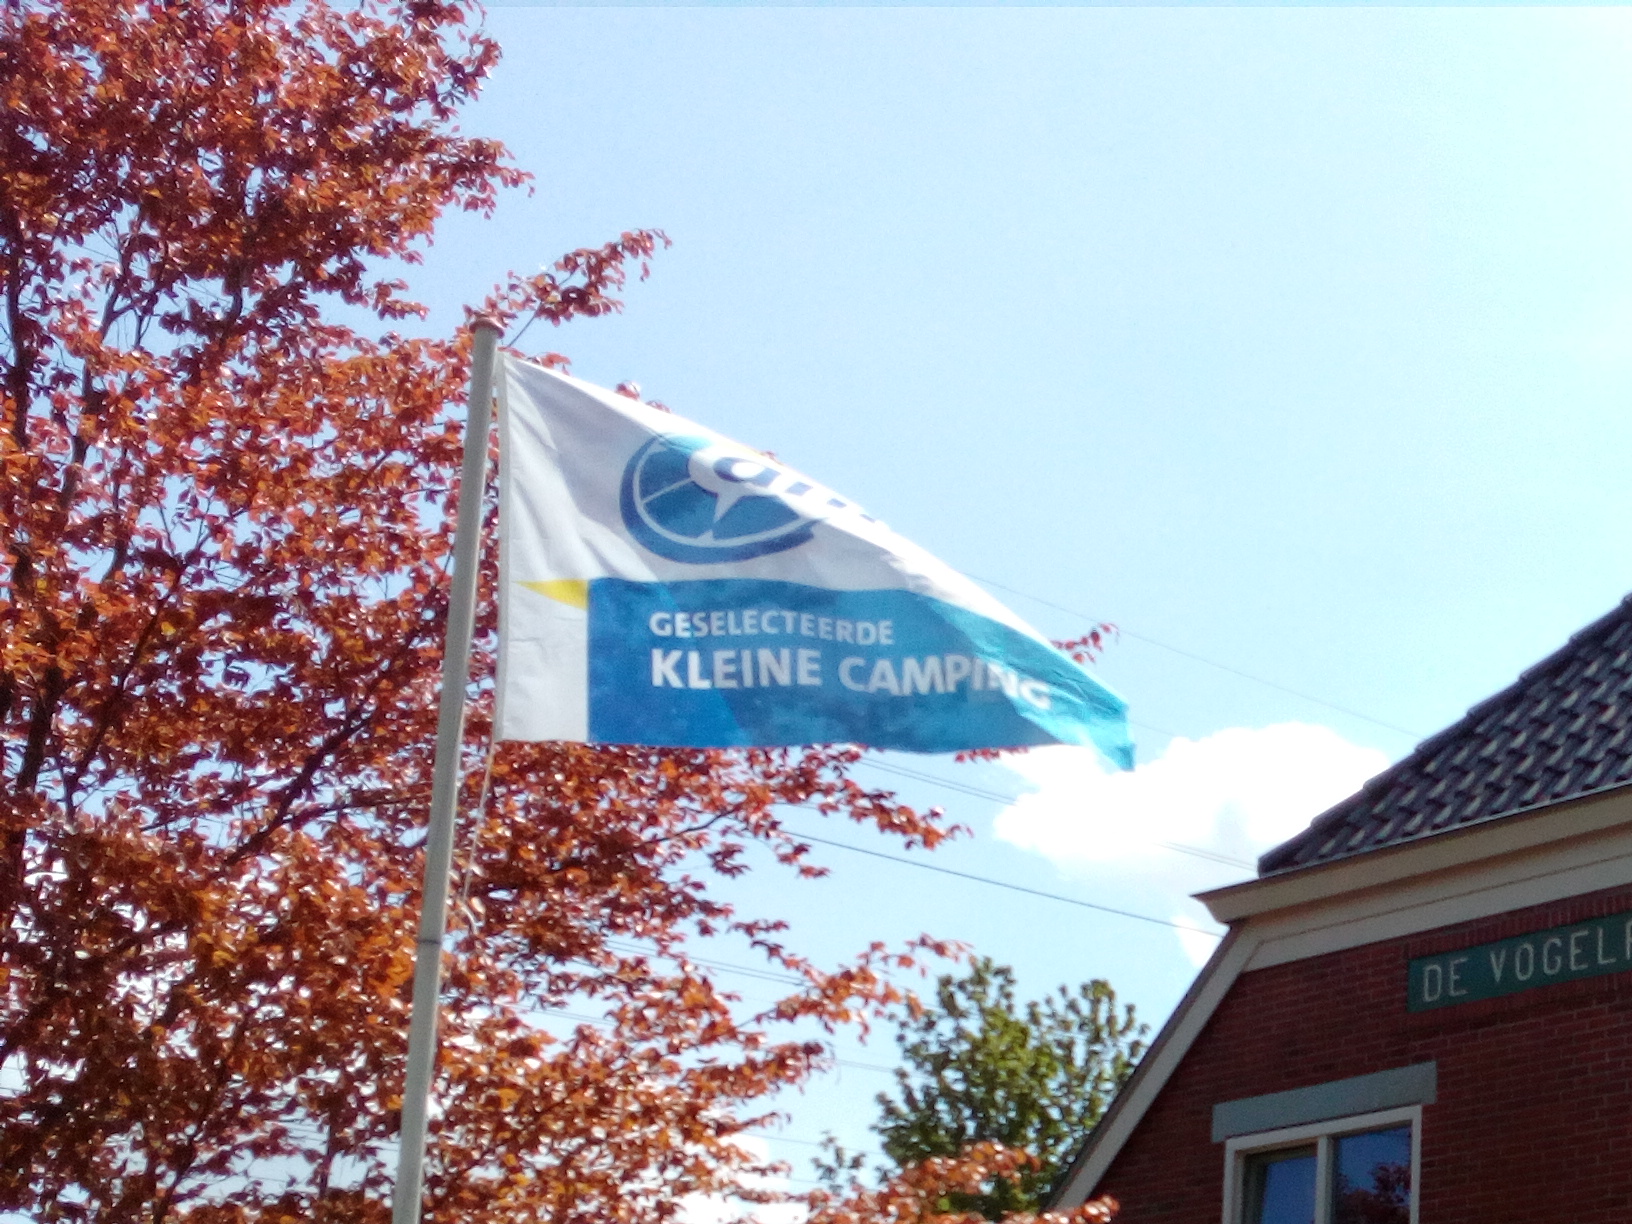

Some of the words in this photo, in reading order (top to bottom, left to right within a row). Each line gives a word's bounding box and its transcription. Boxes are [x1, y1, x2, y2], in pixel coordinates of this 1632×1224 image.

[649, 609, 895, 646] GESELECTEERDE
[651, 649, 822, 690] KLEINE
[838, 655, 1051, 710] CAMPING
[1423, 958, 1469, 1002] DE
